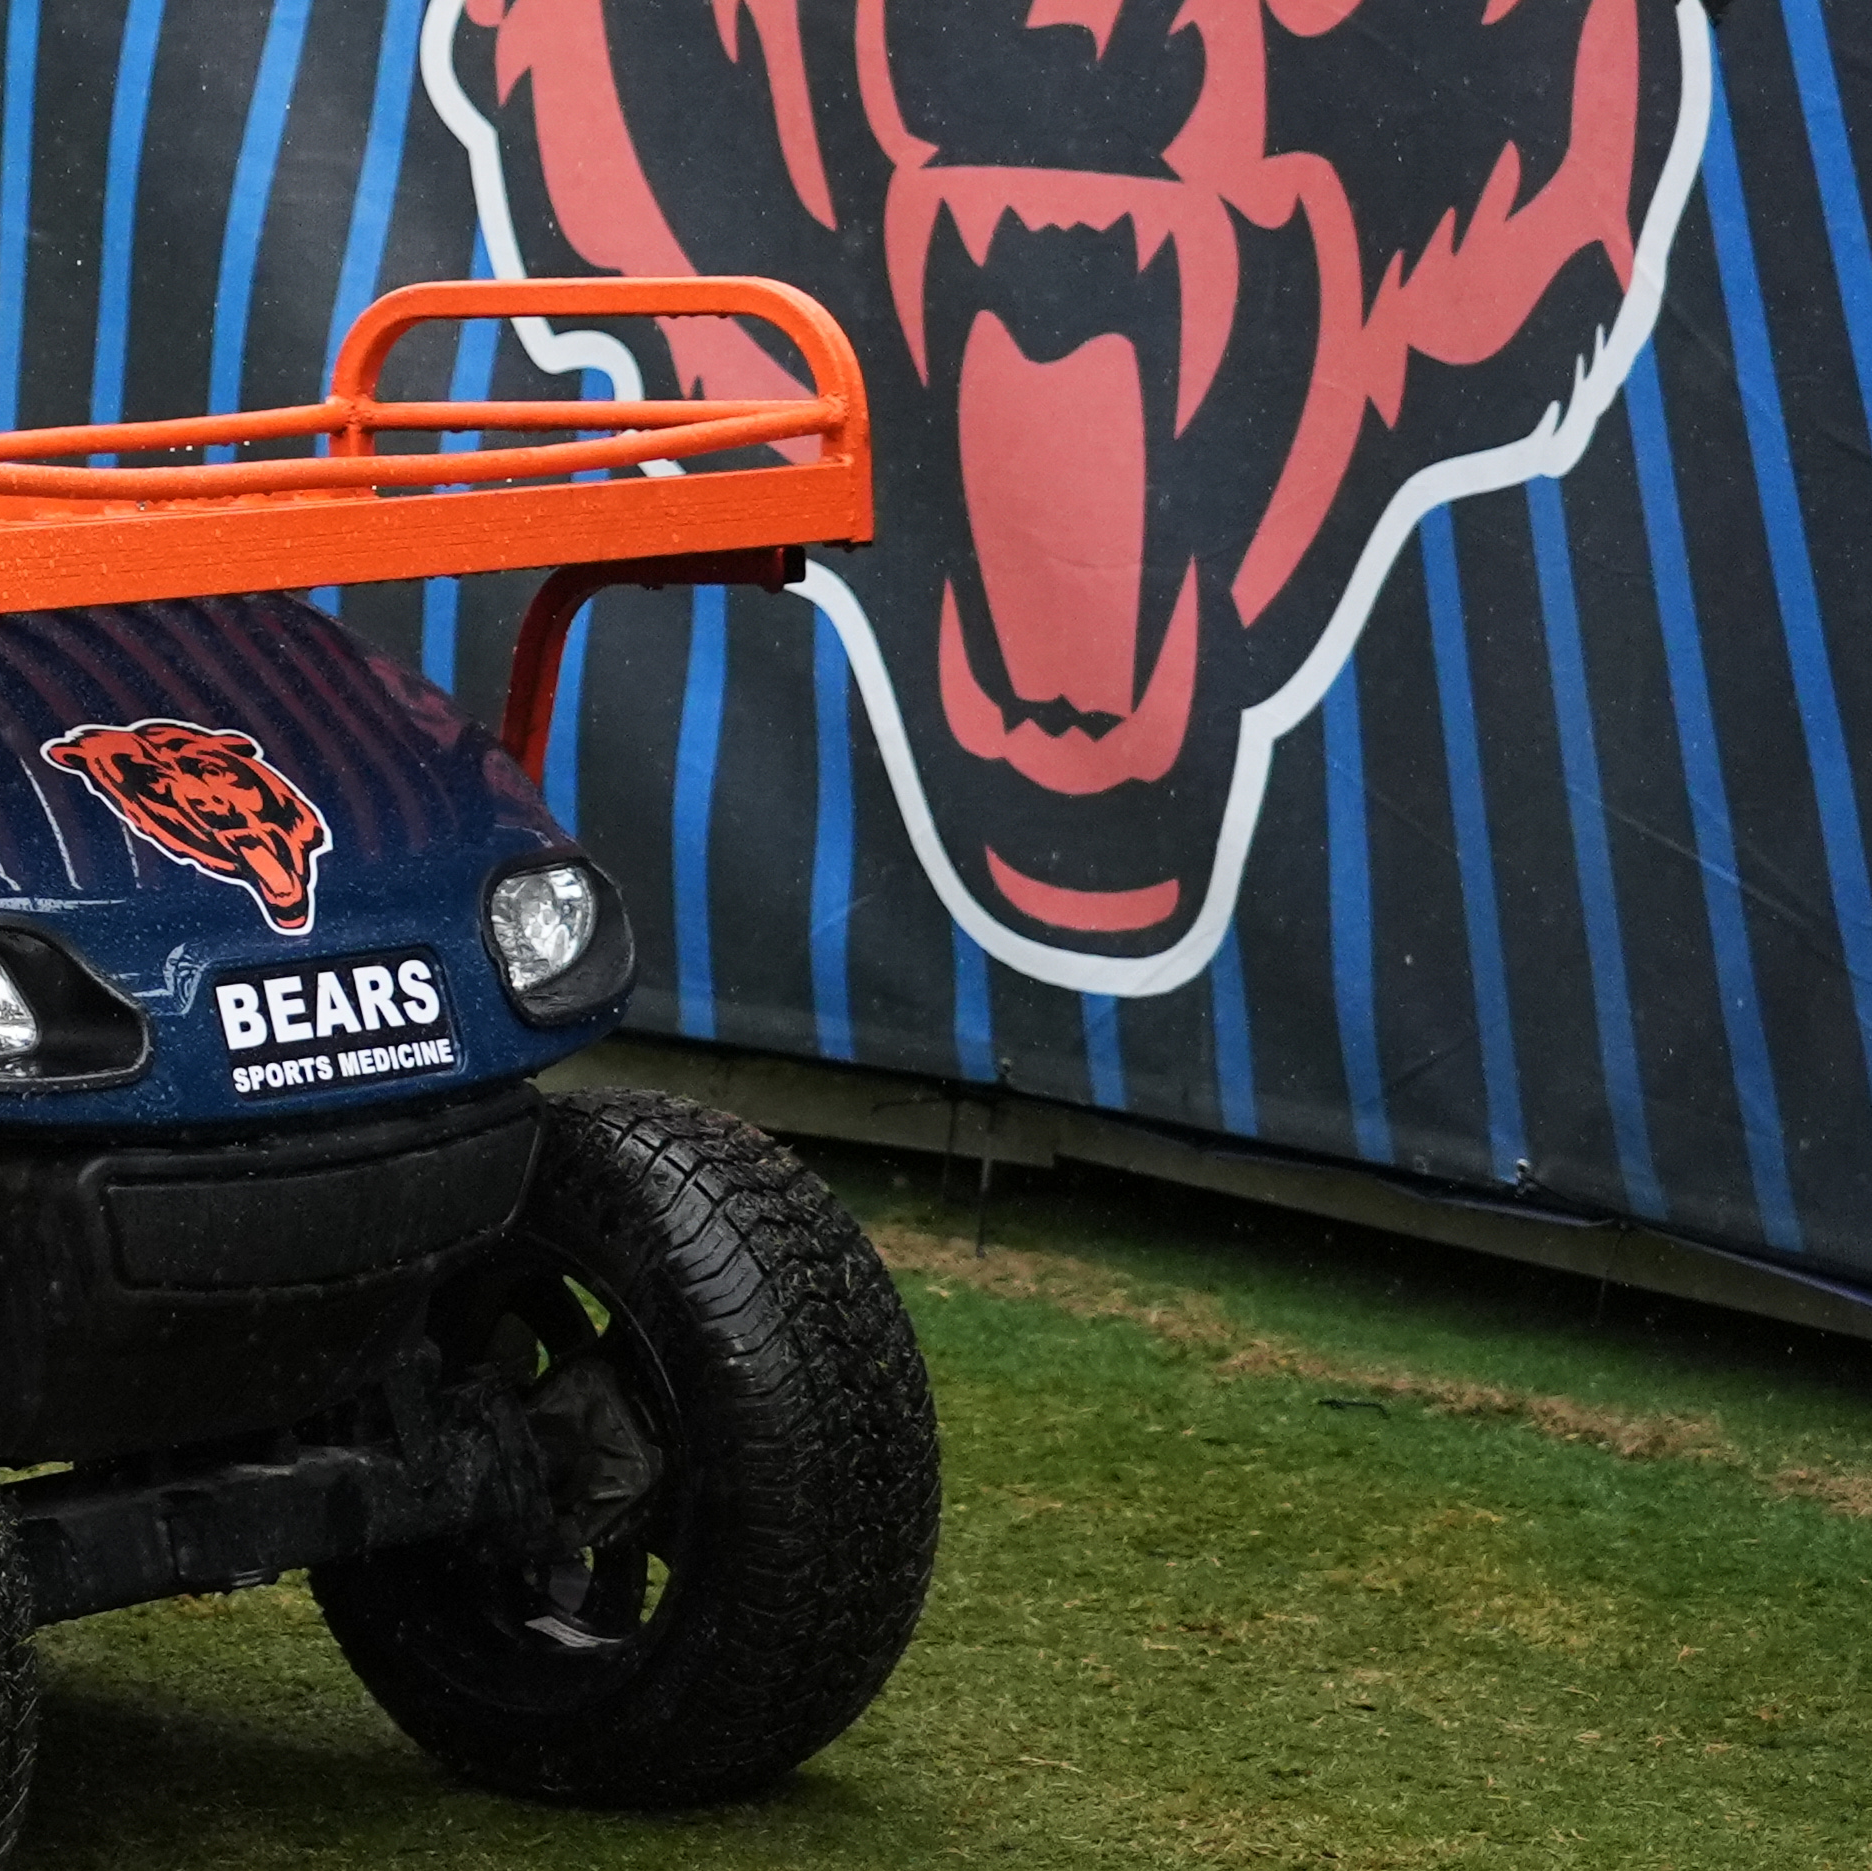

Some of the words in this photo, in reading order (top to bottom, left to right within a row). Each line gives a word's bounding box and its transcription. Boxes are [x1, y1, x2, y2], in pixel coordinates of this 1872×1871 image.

[215, 959, 441, 1051] BEARS
[232, 1055, 334, 1093] SPORTS
[337, 1038, 455, 1077] MEDICINE
